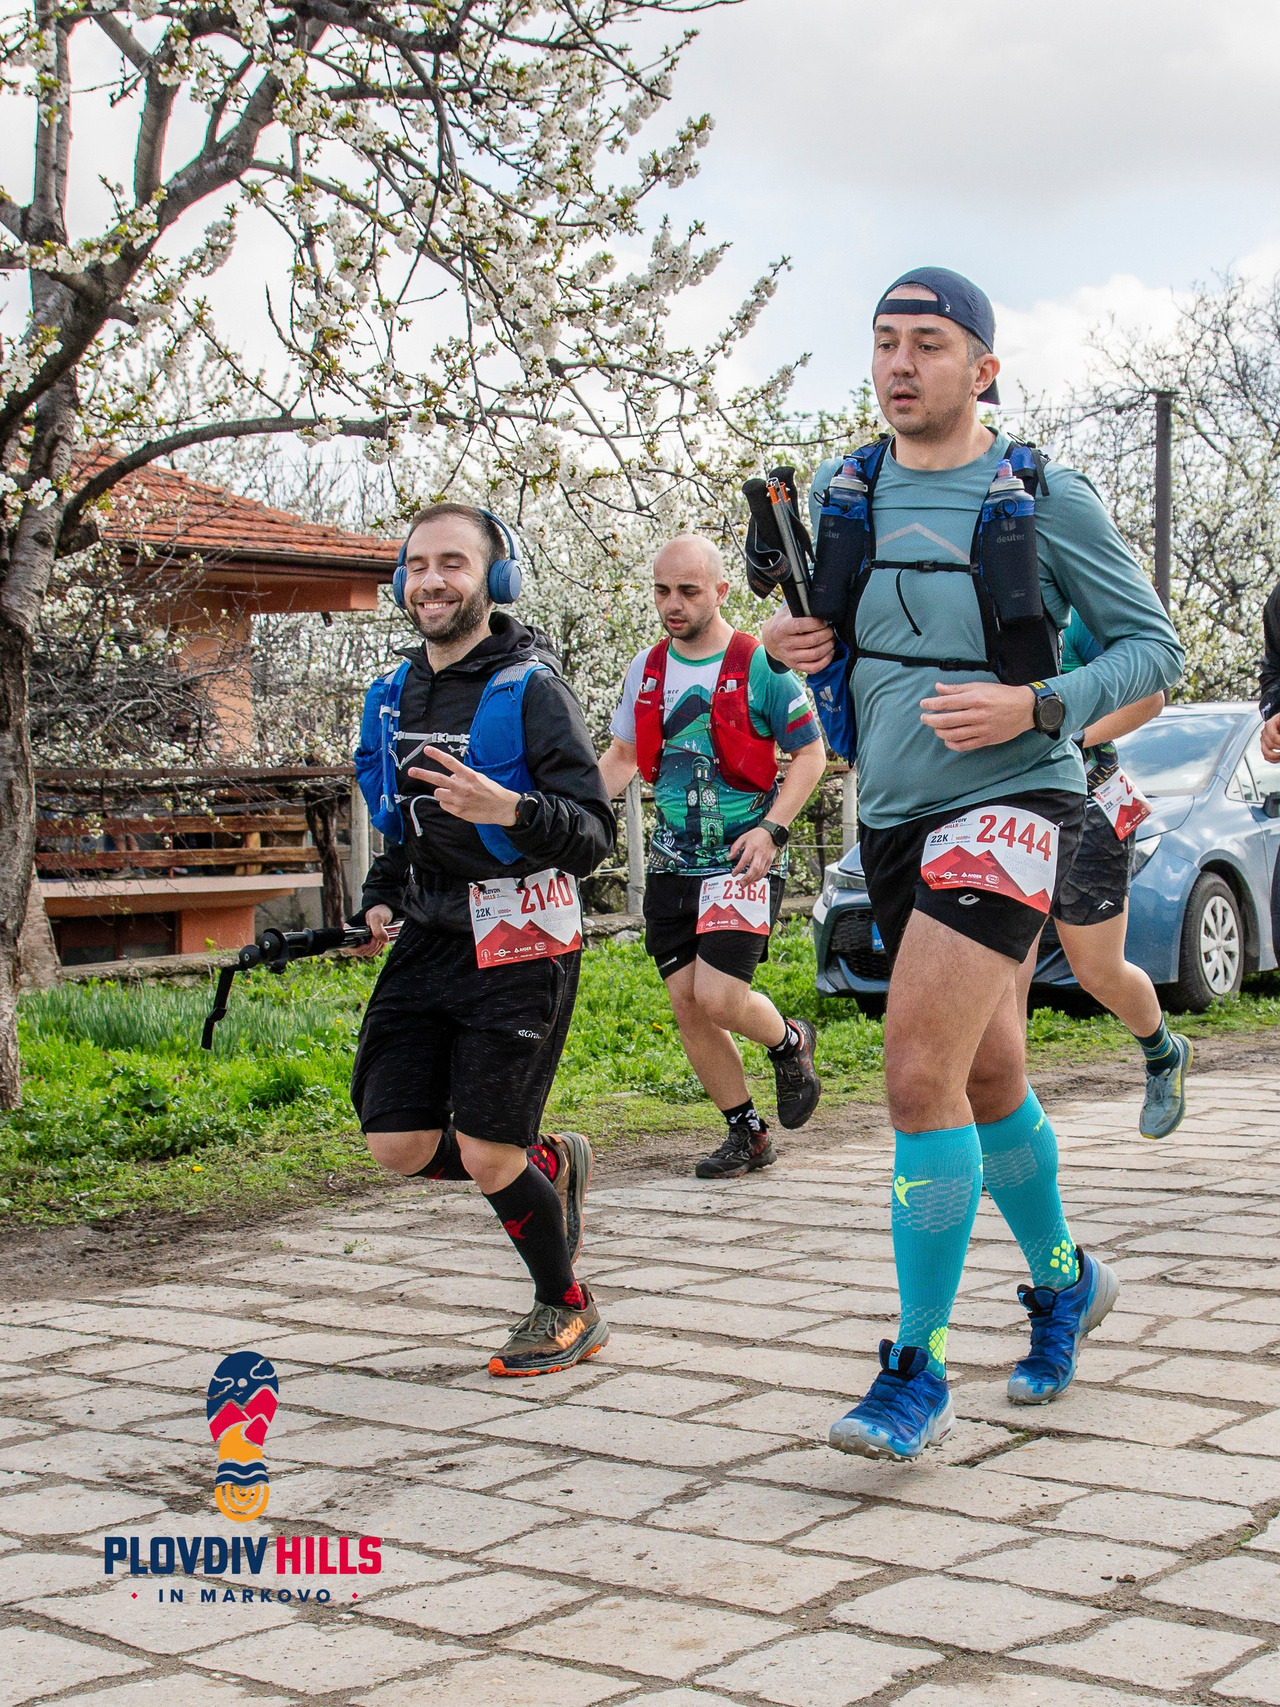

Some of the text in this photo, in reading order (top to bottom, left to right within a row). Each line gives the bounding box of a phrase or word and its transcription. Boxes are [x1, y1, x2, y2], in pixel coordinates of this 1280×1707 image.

[996, 534, 1025, 543] deuter
[931, 834, 948, 843] 22K
[976, 814, 1051, 862] 2444
[516, 877, 573, 914] 2140
[723, 880, 766, 904] 2364
[476, 907, 491, 918] 22K
[555, 1317, 585, 1350] HOKA
